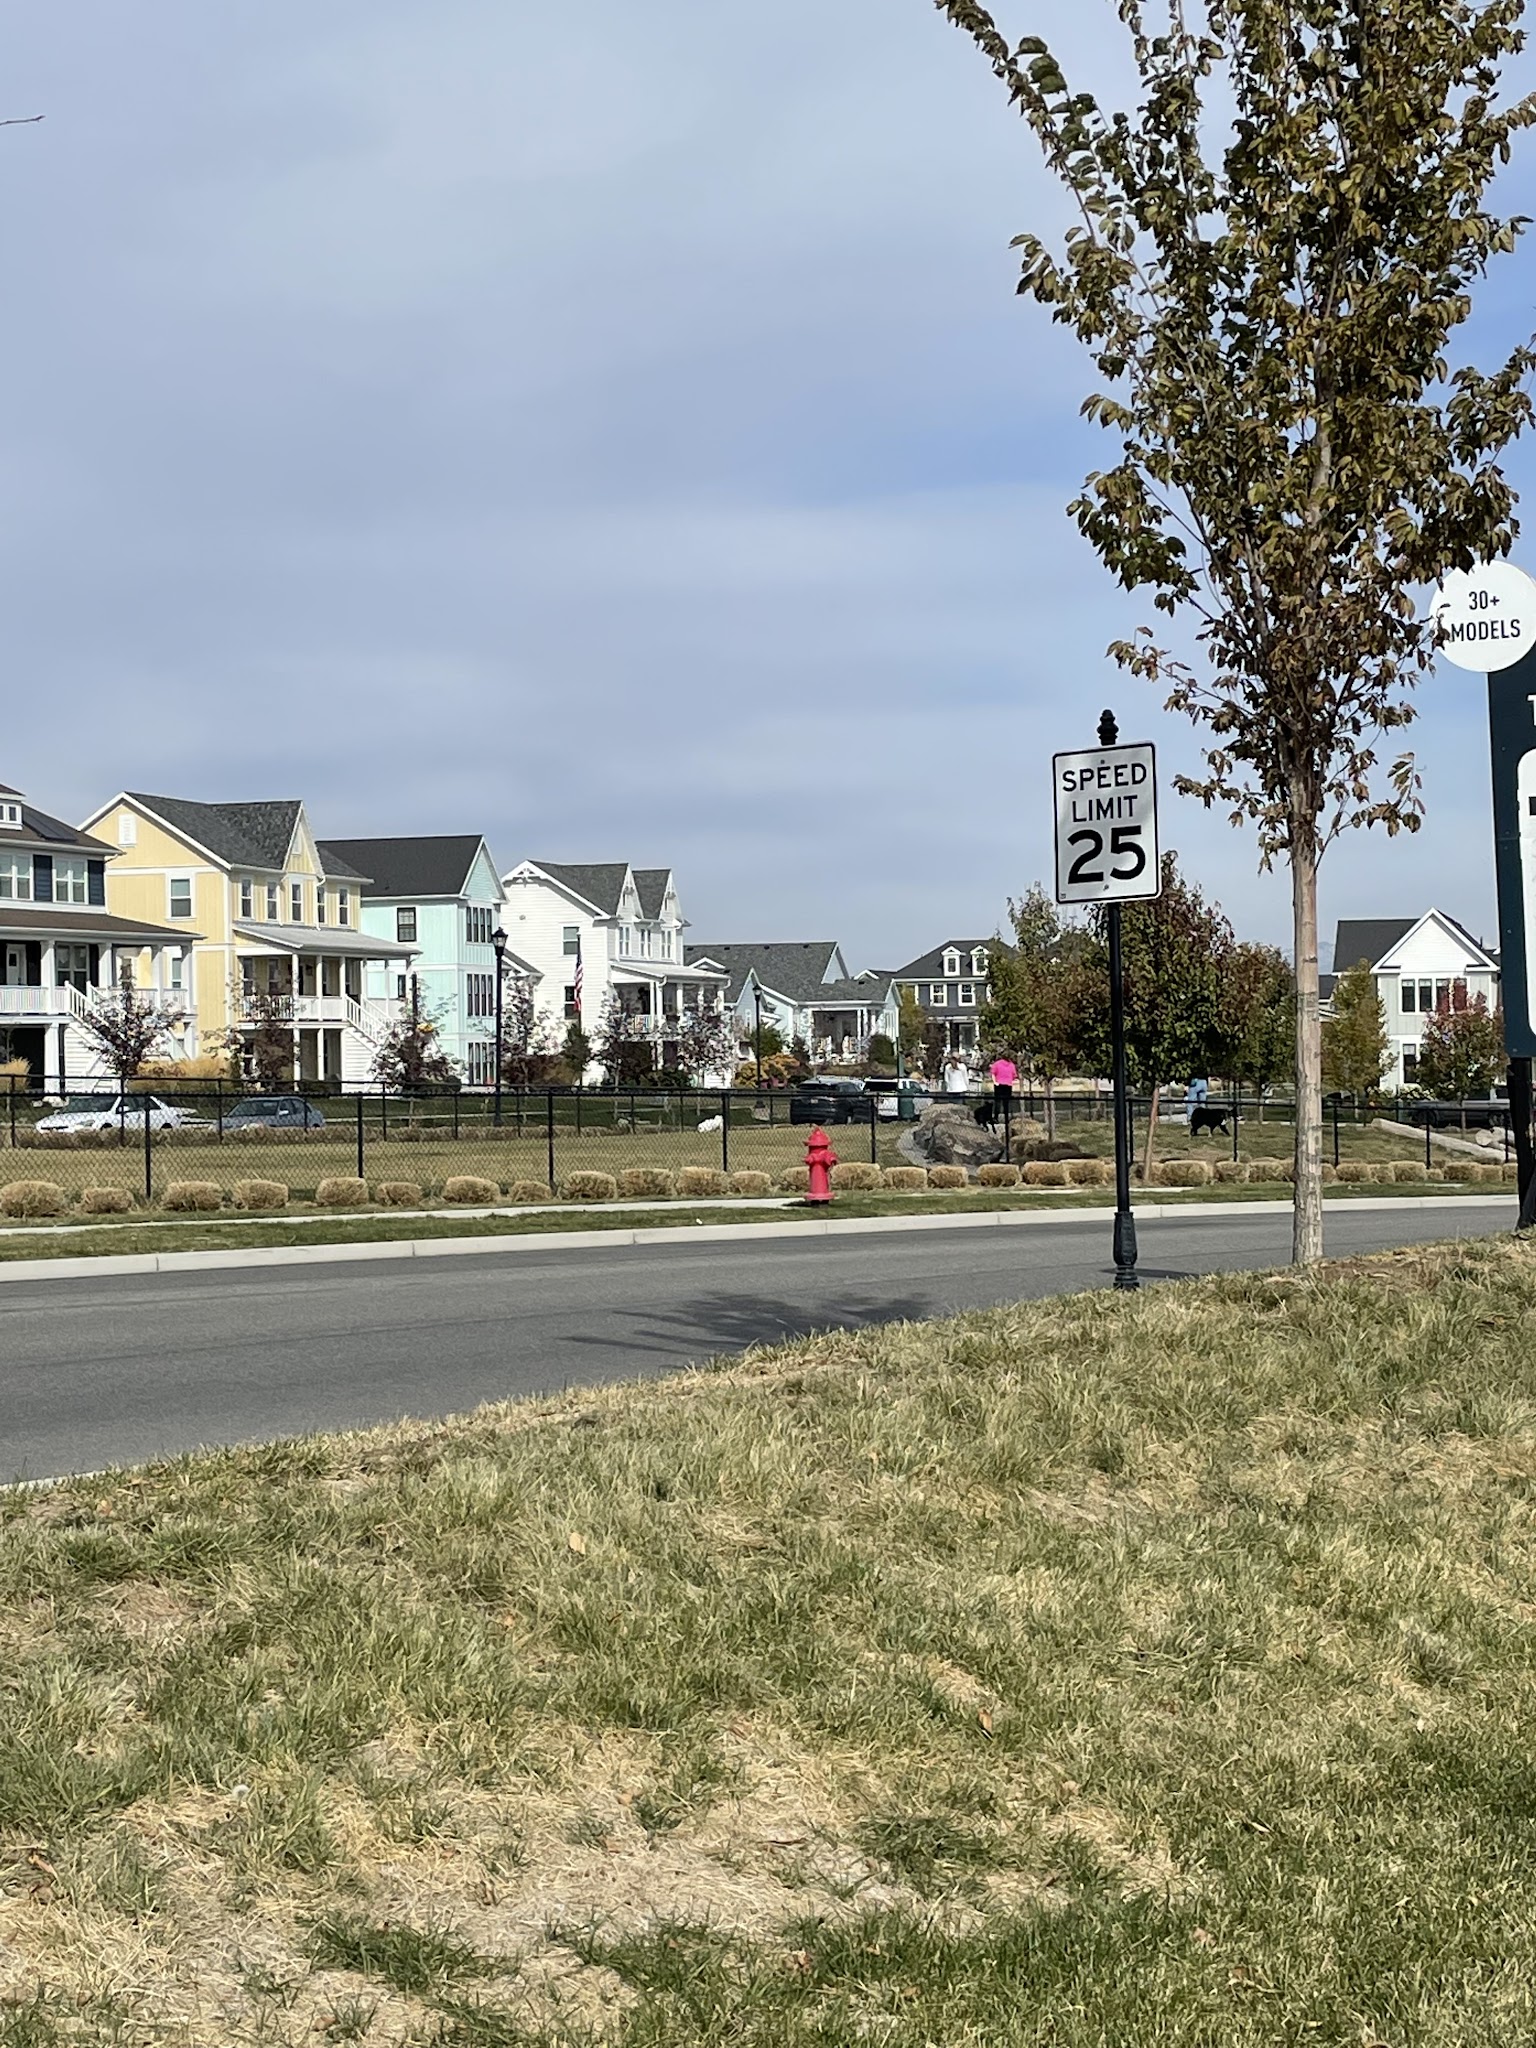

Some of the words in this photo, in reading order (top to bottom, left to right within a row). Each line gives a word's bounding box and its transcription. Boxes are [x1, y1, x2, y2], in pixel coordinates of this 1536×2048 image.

[1469, 590, 1500, 610] 30+
[1451, 619, 1521, 642] MODELS
[1062, 763, 1147, 792] SPEED
[1072, 795, 1138, 823] LIMIT
[1067, 825, 1146, 885] 25
